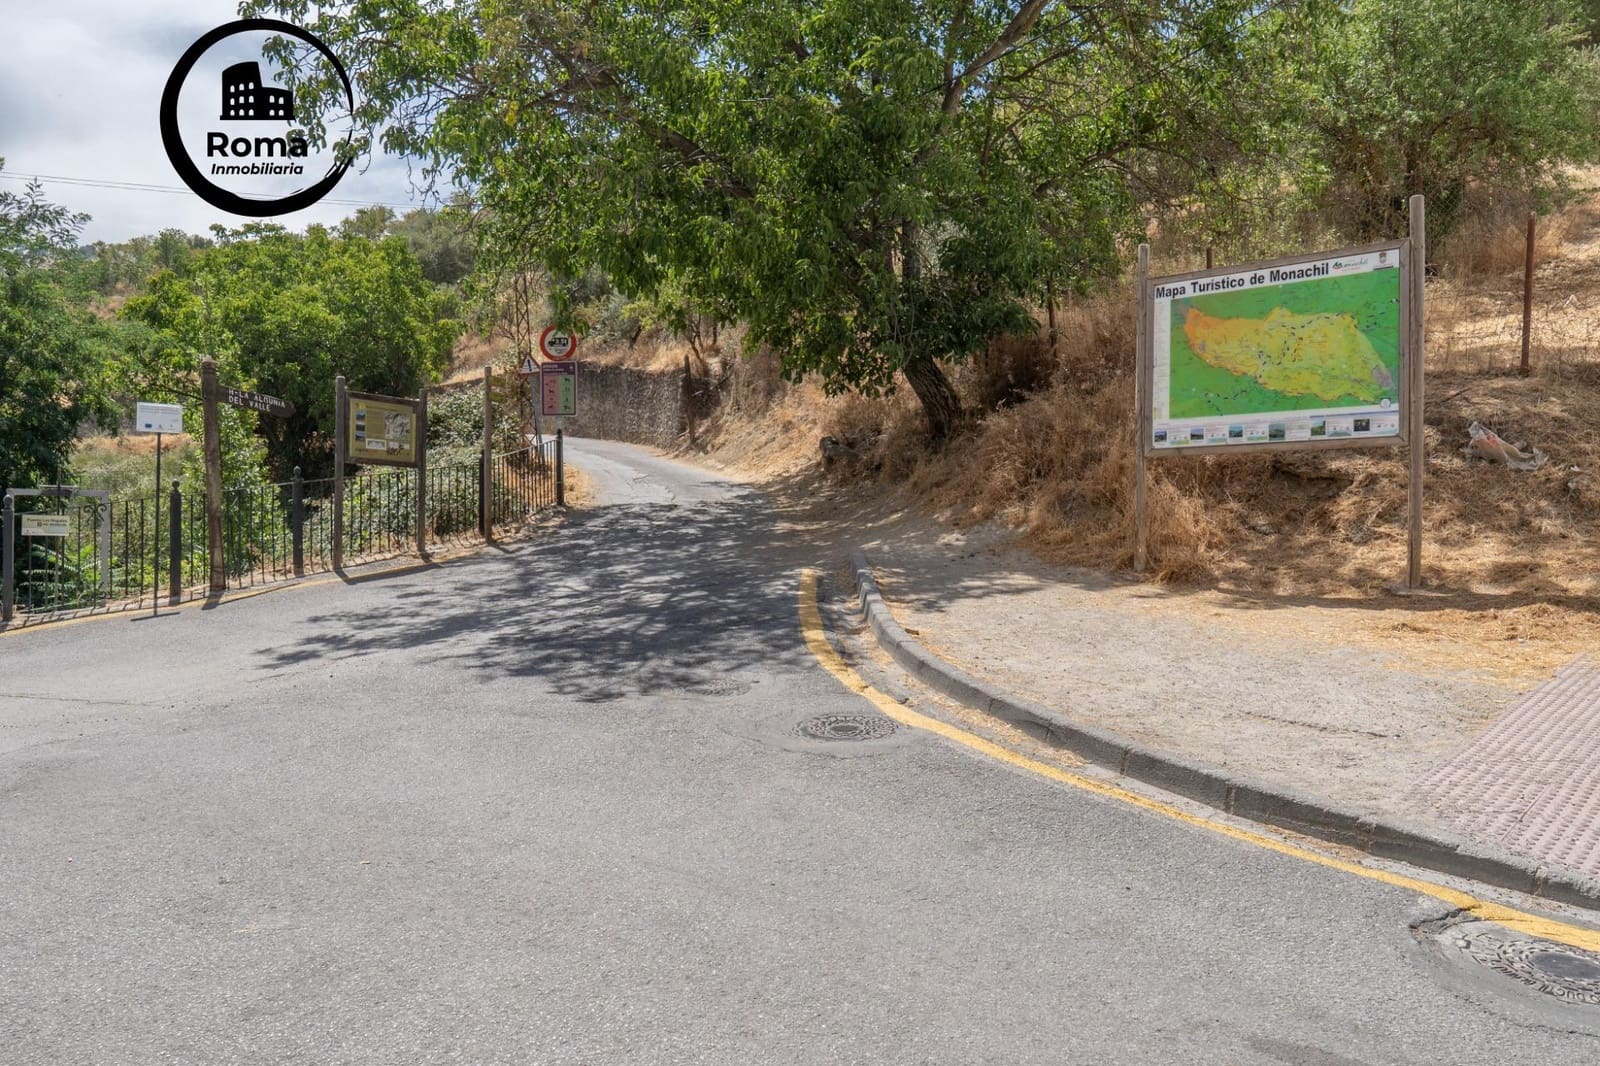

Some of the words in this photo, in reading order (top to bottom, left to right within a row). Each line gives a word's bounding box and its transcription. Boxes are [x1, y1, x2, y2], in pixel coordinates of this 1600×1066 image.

[1156, 285, 1186, 298] Mapa
[1250, 273, 1265, 285] de
[1270, 262, 1329, 283] Monachil
[228, 395, 244, 406] DEL
[249, 401, 271, 412] VALLE
